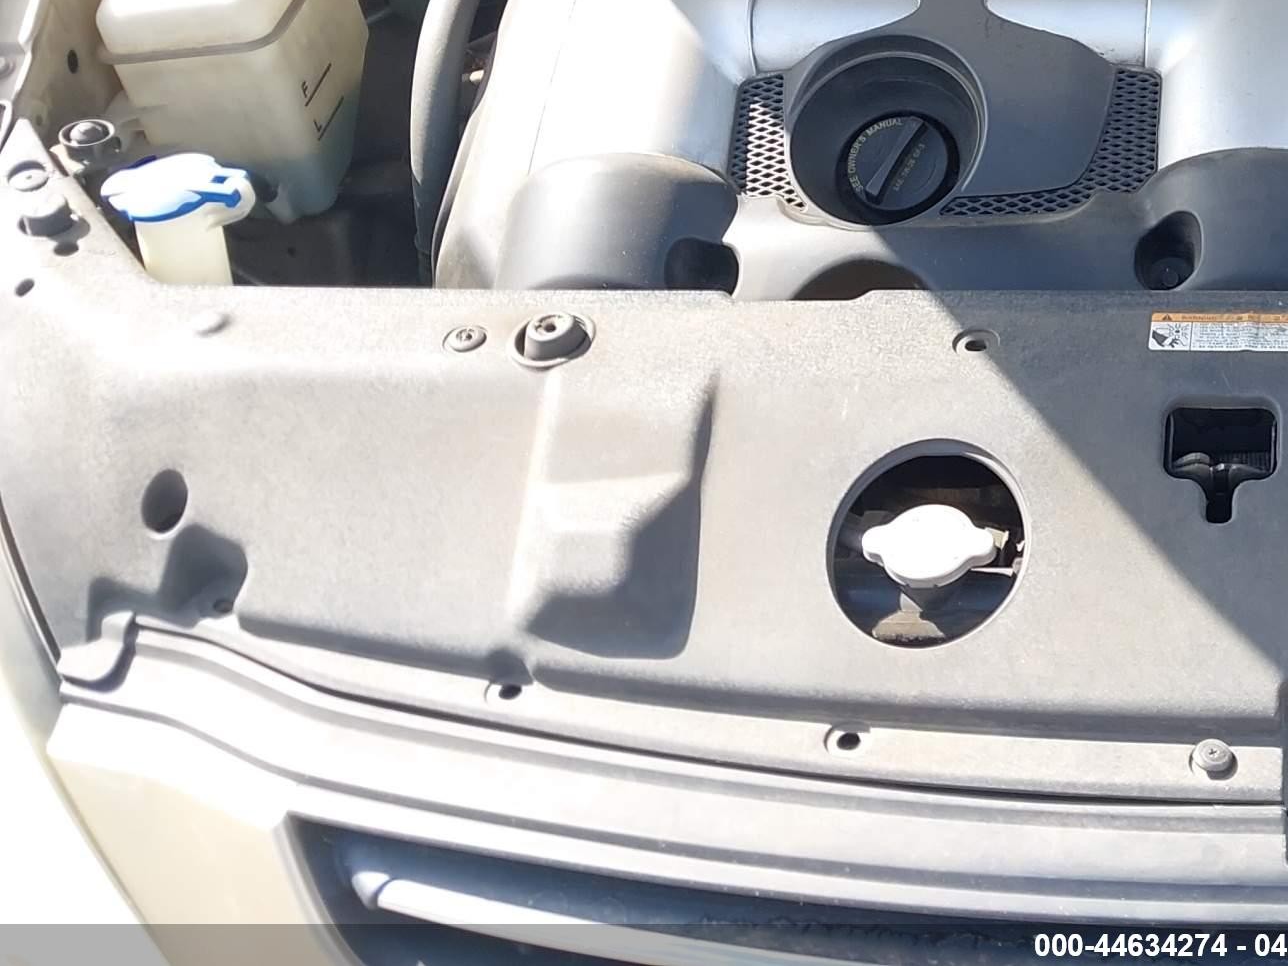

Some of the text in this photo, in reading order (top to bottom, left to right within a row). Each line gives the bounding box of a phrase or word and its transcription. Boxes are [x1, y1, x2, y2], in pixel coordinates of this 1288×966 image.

[301, 80, 308, 98] F
[847, 118, 904, 192] SEE OWNER'S MANUAL
